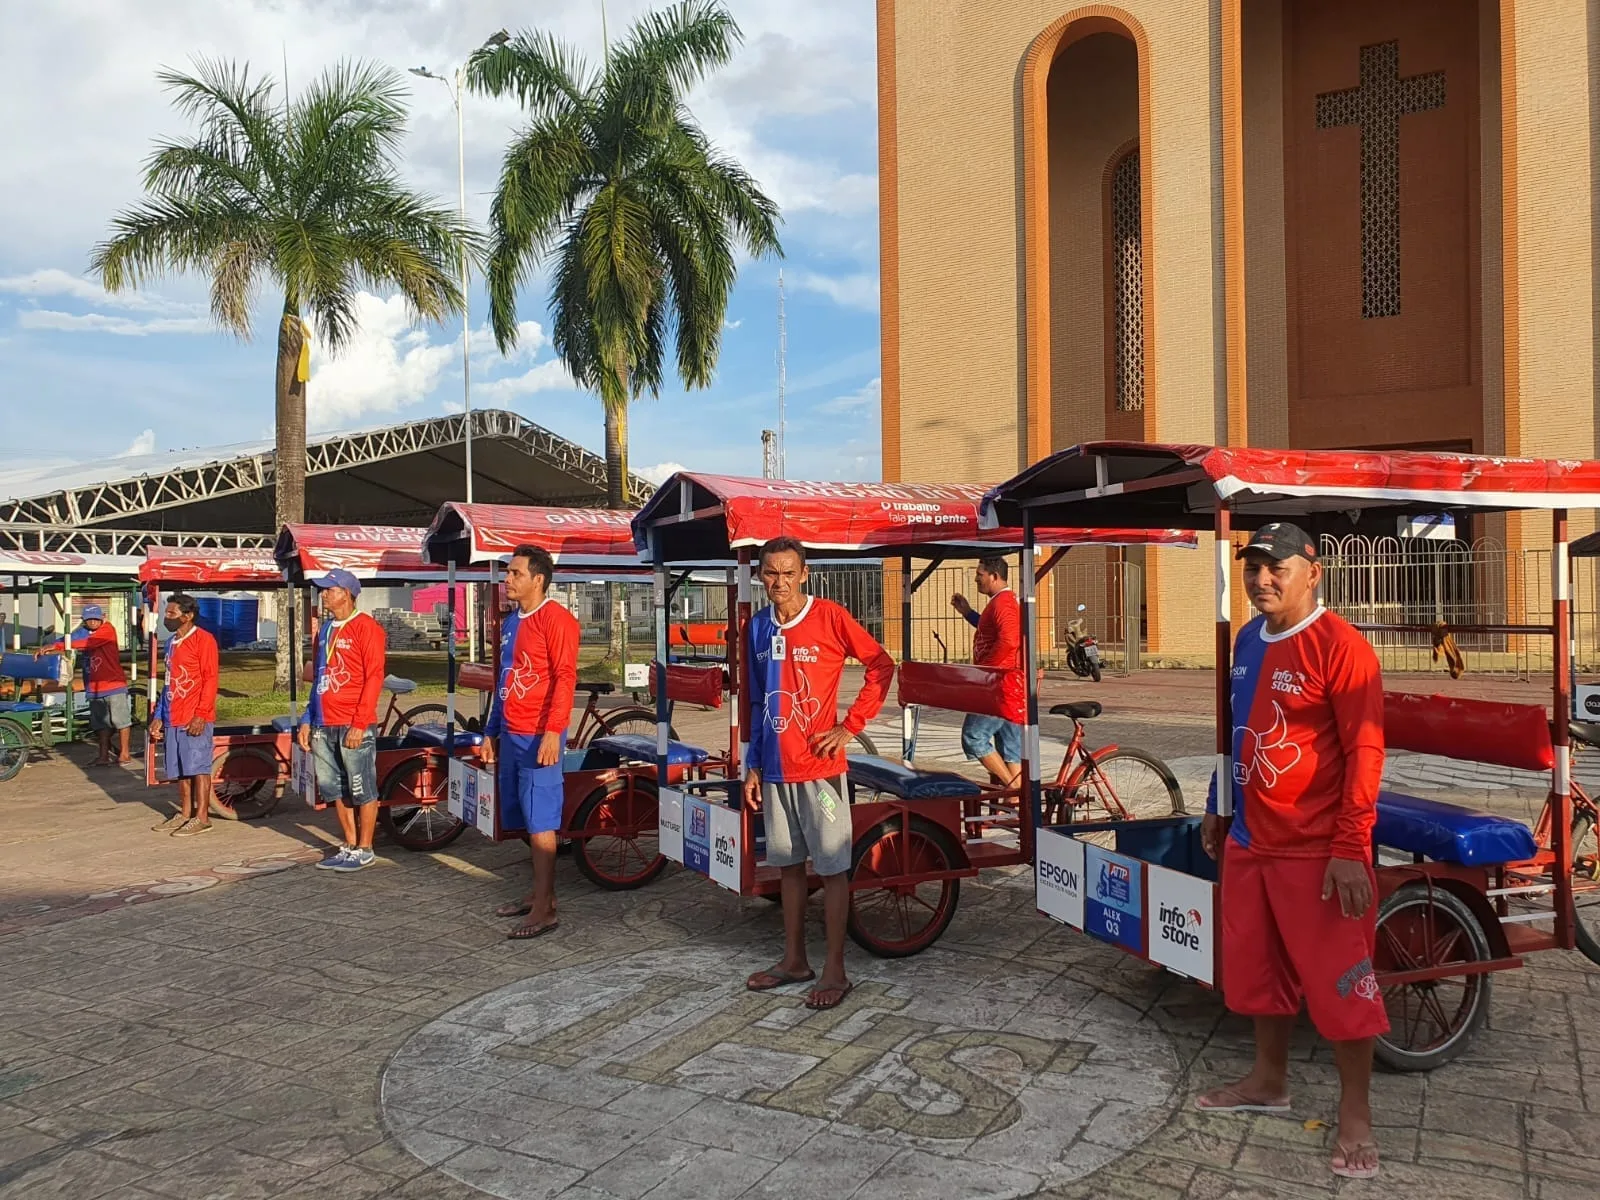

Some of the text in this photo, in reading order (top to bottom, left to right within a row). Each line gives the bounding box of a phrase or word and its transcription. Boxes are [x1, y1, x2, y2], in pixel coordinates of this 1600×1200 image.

[907, 513, 932, 525] pela
[792, 645, 809, 655] info
[793, 654, 817, 662] store
[1272, 668, 1293, 682] info
[1271, 680, 1302, 695] store
[715, 833, 728, 851] info
[716, 850, 734, 868] store
[1039, 860, 1078, 891] EPSON
[1103, 907, 1121, 921] ALEX
[1159, 902, 1186, 927] info
[1106, 920, 1120, 936] 03
[1161, 924, 1200, 951] store
